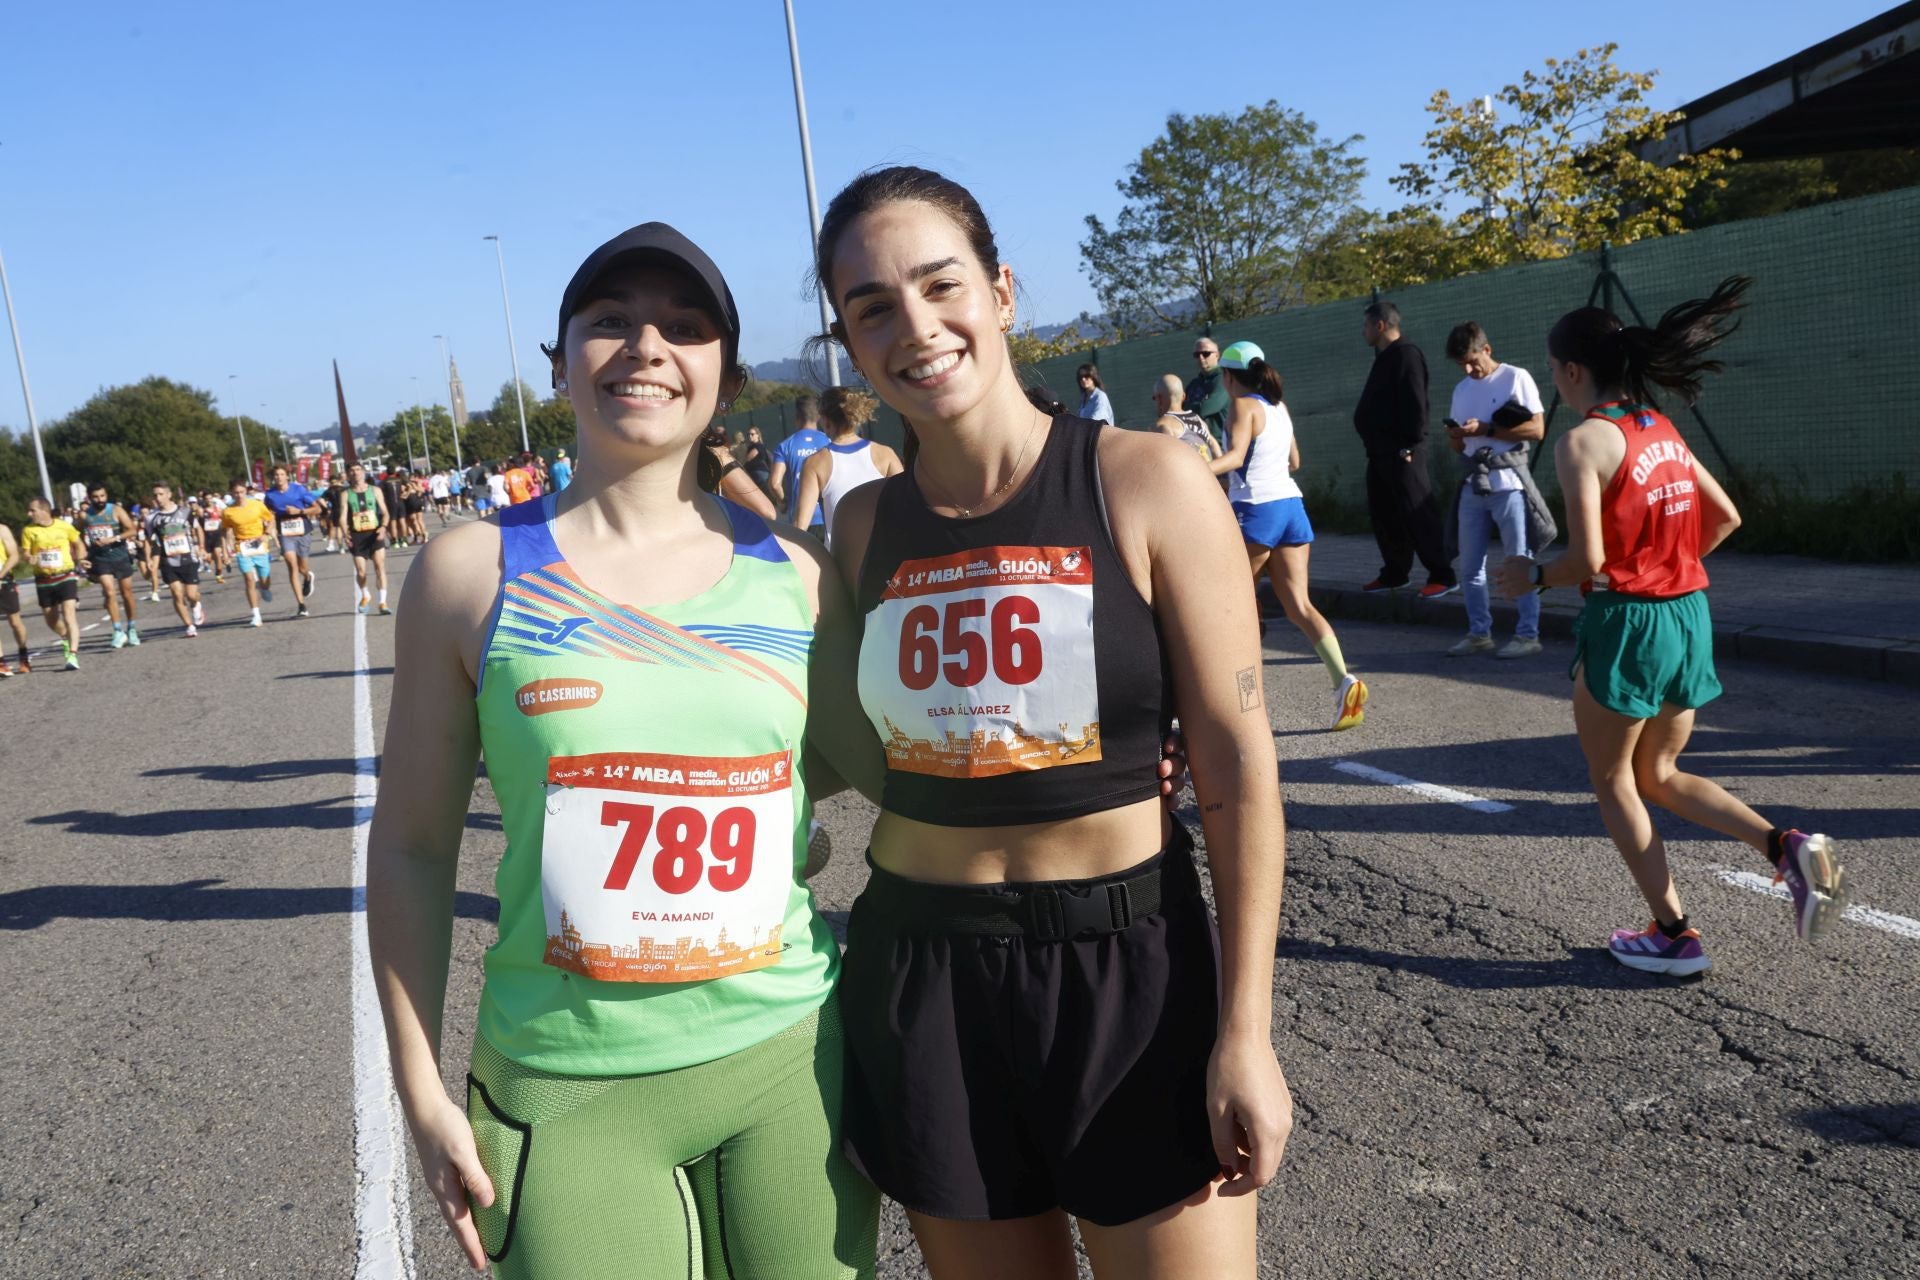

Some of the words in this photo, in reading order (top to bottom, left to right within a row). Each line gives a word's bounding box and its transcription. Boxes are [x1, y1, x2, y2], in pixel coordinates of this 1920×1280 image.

[926, 566, 964, 584] MBA
[998, 557, 1051, 574] GIJÓN
[966, 560, 988, 570] media
[966, 567, 998, 578] maratón
[899, 595, 1042, 690] 656
[519, 691, 536, 706] LOS
[539, 687, 597, 703] CASERINOS
[927, 706, 955, 717] ELSA
[957, 703, 1011, 716] ÁLVAREZ
[632, 766, 685, 785] MBA
[728, 767, 769, 786] GIJÓN
[689, 769, 718, 778] media
[689, 778, 726, 786] maratón
[600, 801, 756, 894] 789
[632, 911, 657, 921] EVA
[661, 911, 714, 922] AMANDI
[643, 962, 667, 972] gijón
